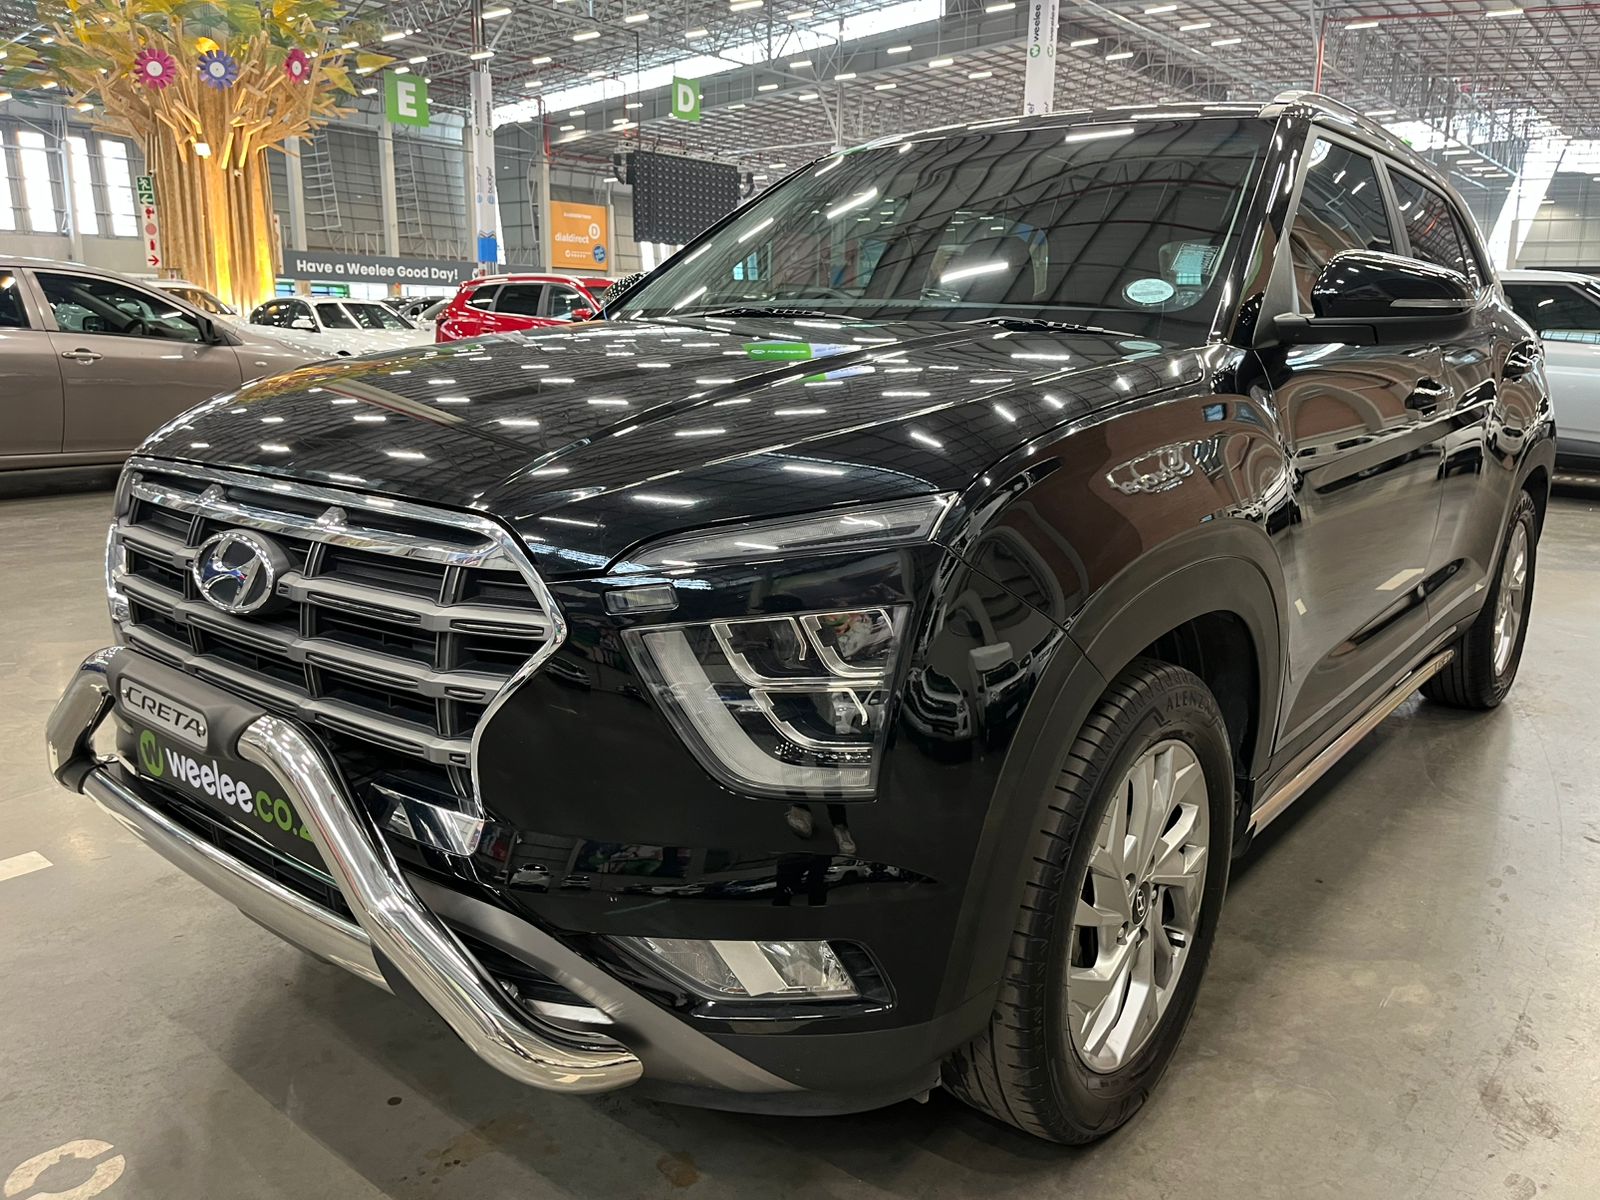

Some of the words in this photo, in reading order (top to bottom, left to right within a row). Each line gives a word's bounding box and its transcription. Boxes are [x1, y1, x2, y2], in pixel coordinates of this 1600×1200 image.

[1033, 4, 1041, 41] weelee
[397, 80, 417, 118] E
[678, 83, 695, 113] D
[296, 259, 333, 274] Have
[335, 264, 345, 275] a
[347, 262, 395, 277] Weelee
[397, 265, 429, 279] Good
[431, 267, 458, 283] Day!
[127, 685, 206, 739] CRETA
